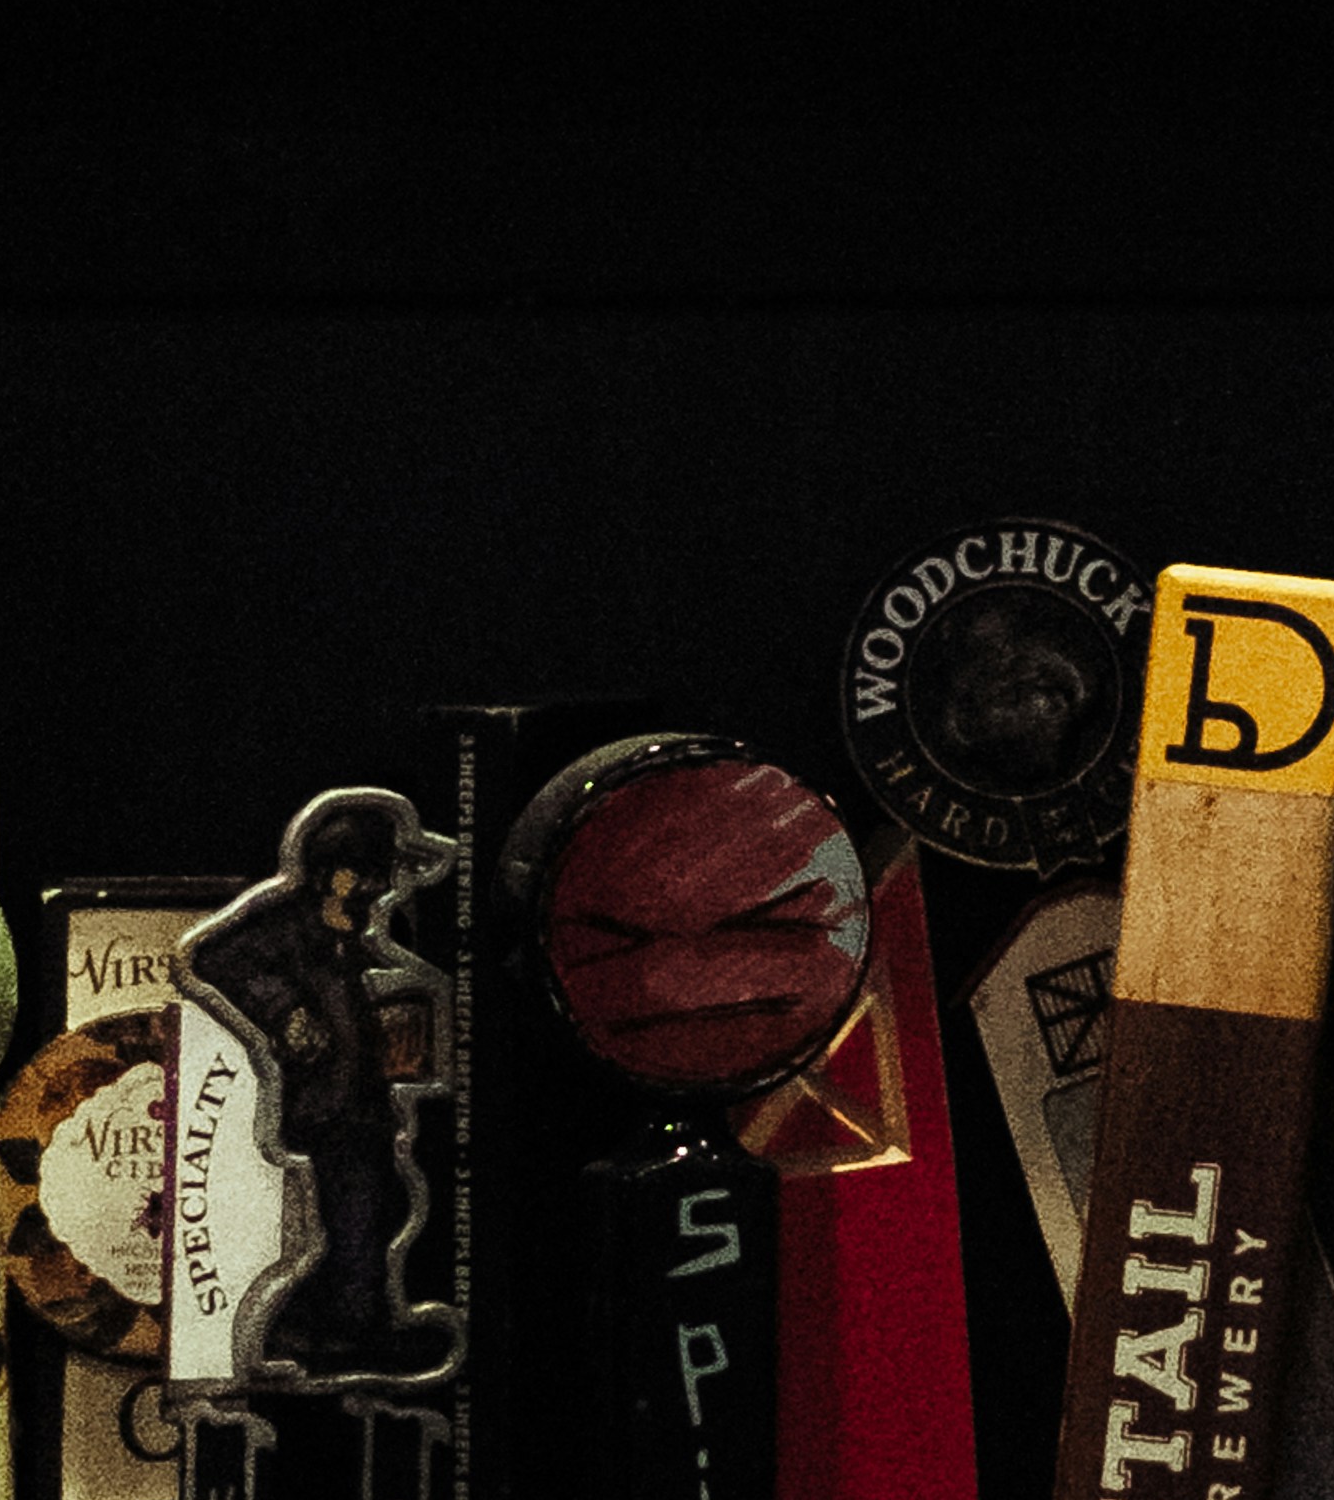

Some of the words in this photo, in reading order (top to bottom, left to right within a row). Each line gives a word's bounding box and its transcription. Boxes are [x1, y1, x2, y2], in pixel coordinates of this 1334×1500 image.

[855, 531, 1153, 722] WOODCHUCK
[874, 749, 1010, 847] HARD
[178, 1051, 240, 1317] SPECIALTY
